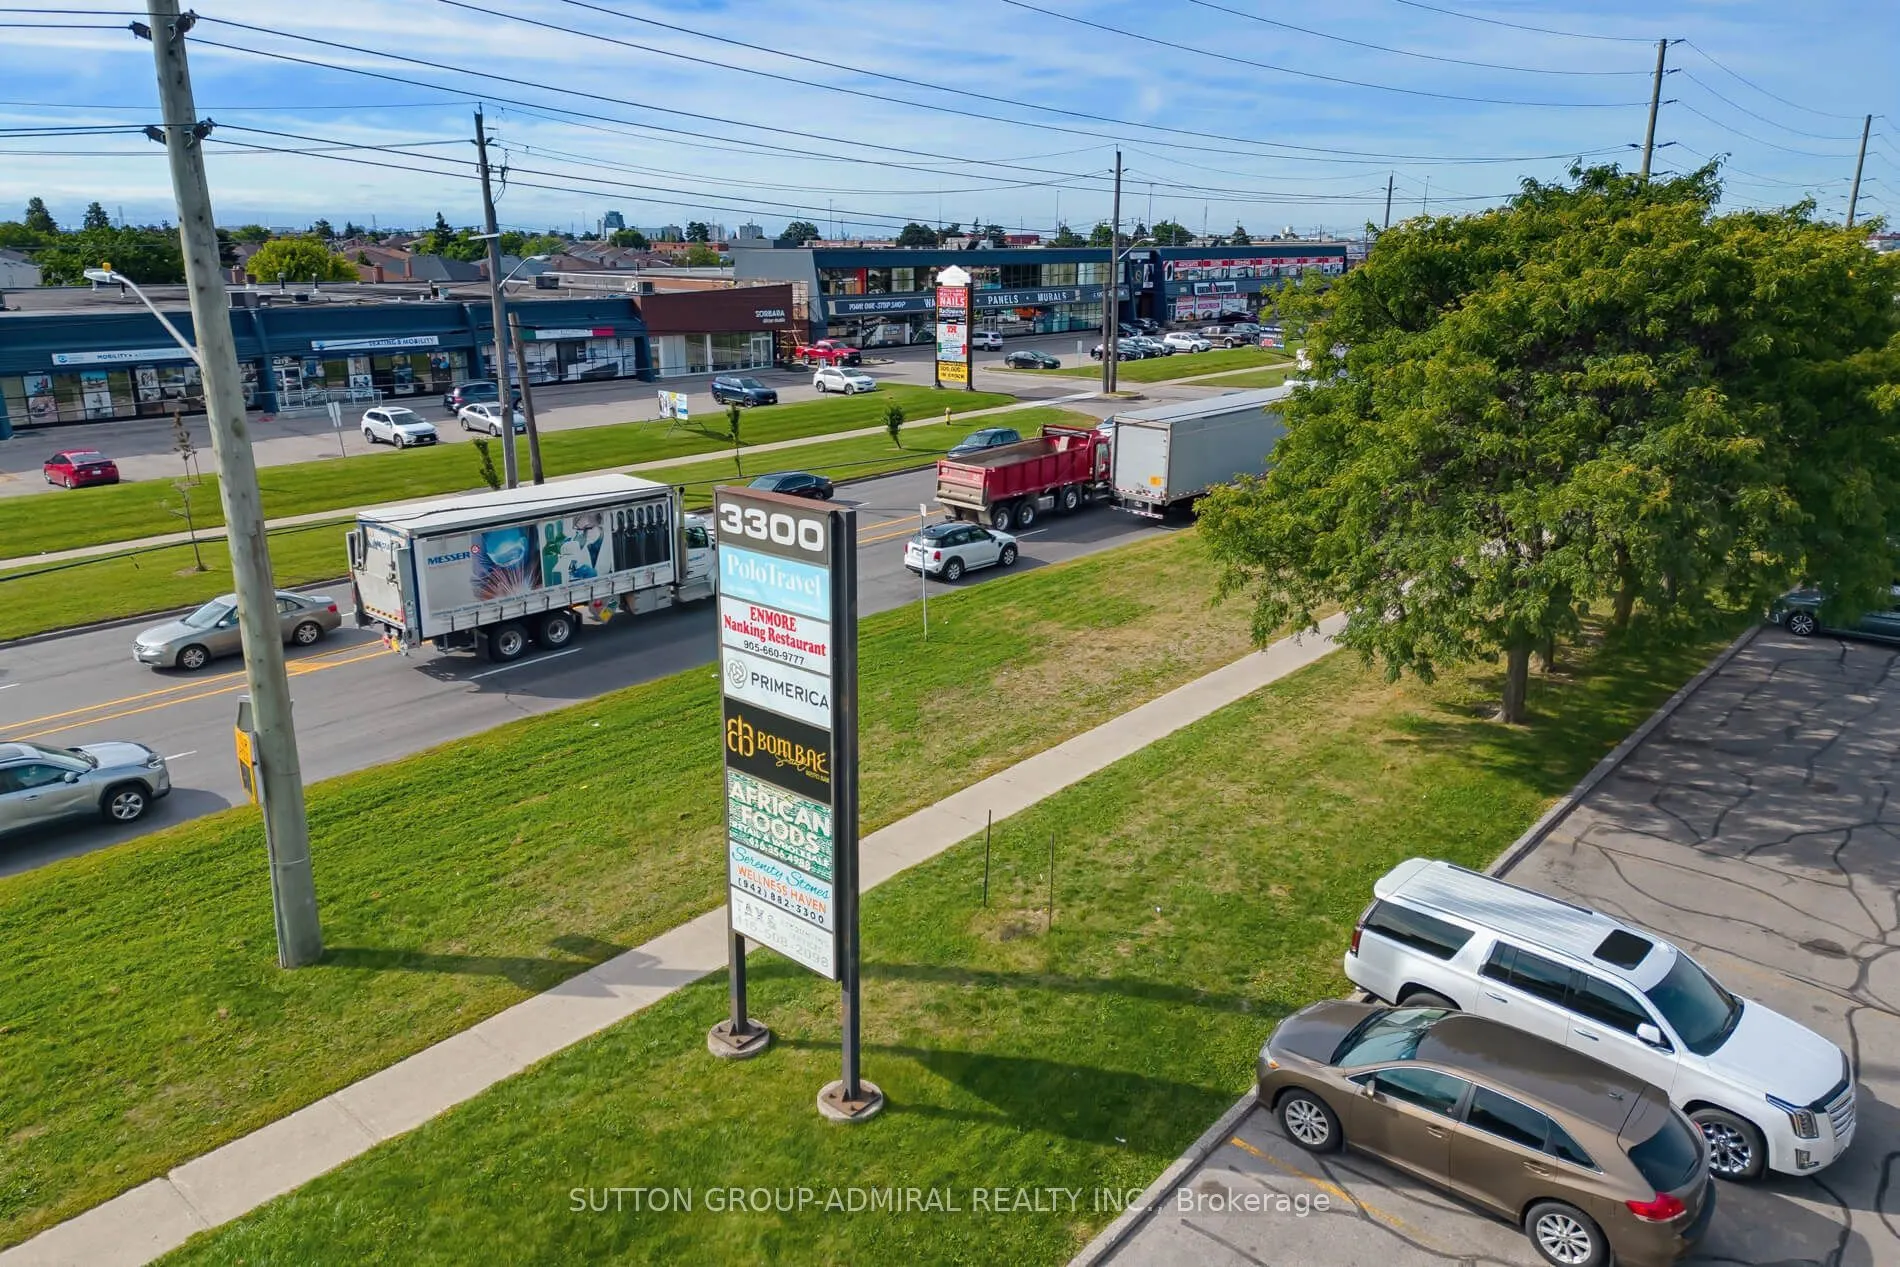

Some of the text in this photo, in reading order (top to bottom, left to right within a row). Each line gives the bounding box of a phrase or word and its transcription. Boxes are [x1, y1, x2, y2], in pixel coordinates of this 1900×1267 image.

[988, 294, 1018, 305] PANELS
[1037, 292, 1067, 302] MURALS
[720, 503, 824, 552] 3300
[428, 552, 470, 566] MESSER
[727, 554, 820, 597] PoloTravel
[723, 614, 826, 656] Nanking Restaurant
[750, 606, 797, 632] ENMORE
[743, 640, 804, 666] 905-660-9777
[751, 672, 830, 710] PRIMERICA
[728, 782, 830, 837] AFRICAN
[741, 804, 820, 854] FOODS
[732, 846, 830, 899] Serenity Stones
[737, 864, 826, 914] WELLNESS HAVEN
